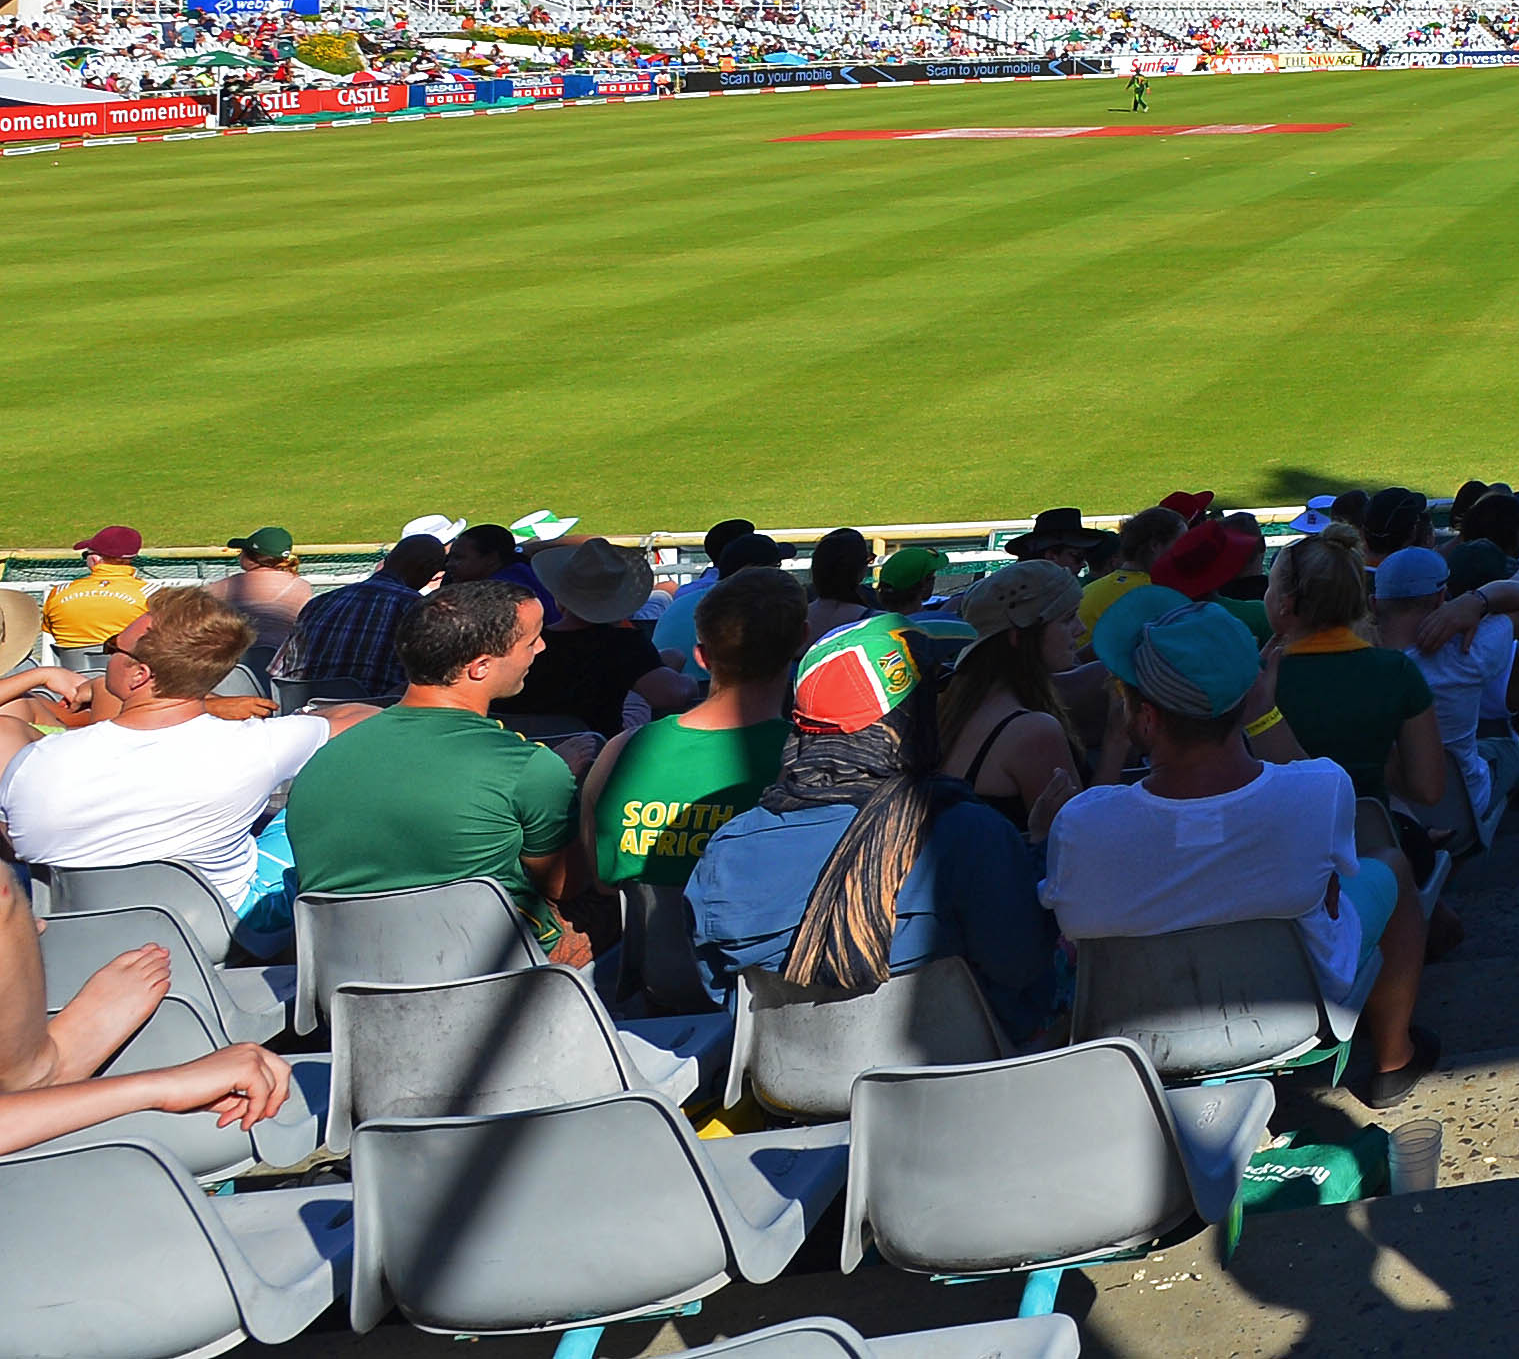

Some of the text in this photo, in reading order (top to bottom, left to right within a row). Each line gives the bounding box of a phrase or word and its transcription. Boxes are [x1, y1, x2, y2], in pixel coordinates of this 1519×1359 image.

[1131, 57, 1179, 73] Sunfoil
[1211, 57, 1276, 72] SAHARA
[1285, 56, 1305, 67] THE
[1308, 55, 1335, 67] NEW
[1459, 51, 1519, 64] Investec
[720, 68, 833, 86] Scan to your mobile
[926, 61, 1040, 78] Scan to your mobile
[425, 83, 464, 94] NASHUA
[514, 87, 563, 98] MOBILE
[599, 83, 650, 92] MOBILE
[239, 91, 300, 111] CSTLE
[337, 87, 390, 106] CASTLE
[426, 93, 475, 105] MOBILE
[355, 105, 376, 113] LAGER
[0, 111, 97, 132] omentum
[622, 800, 734, 830] SOUTH
[620, 828, 710, 857] AFRIC
